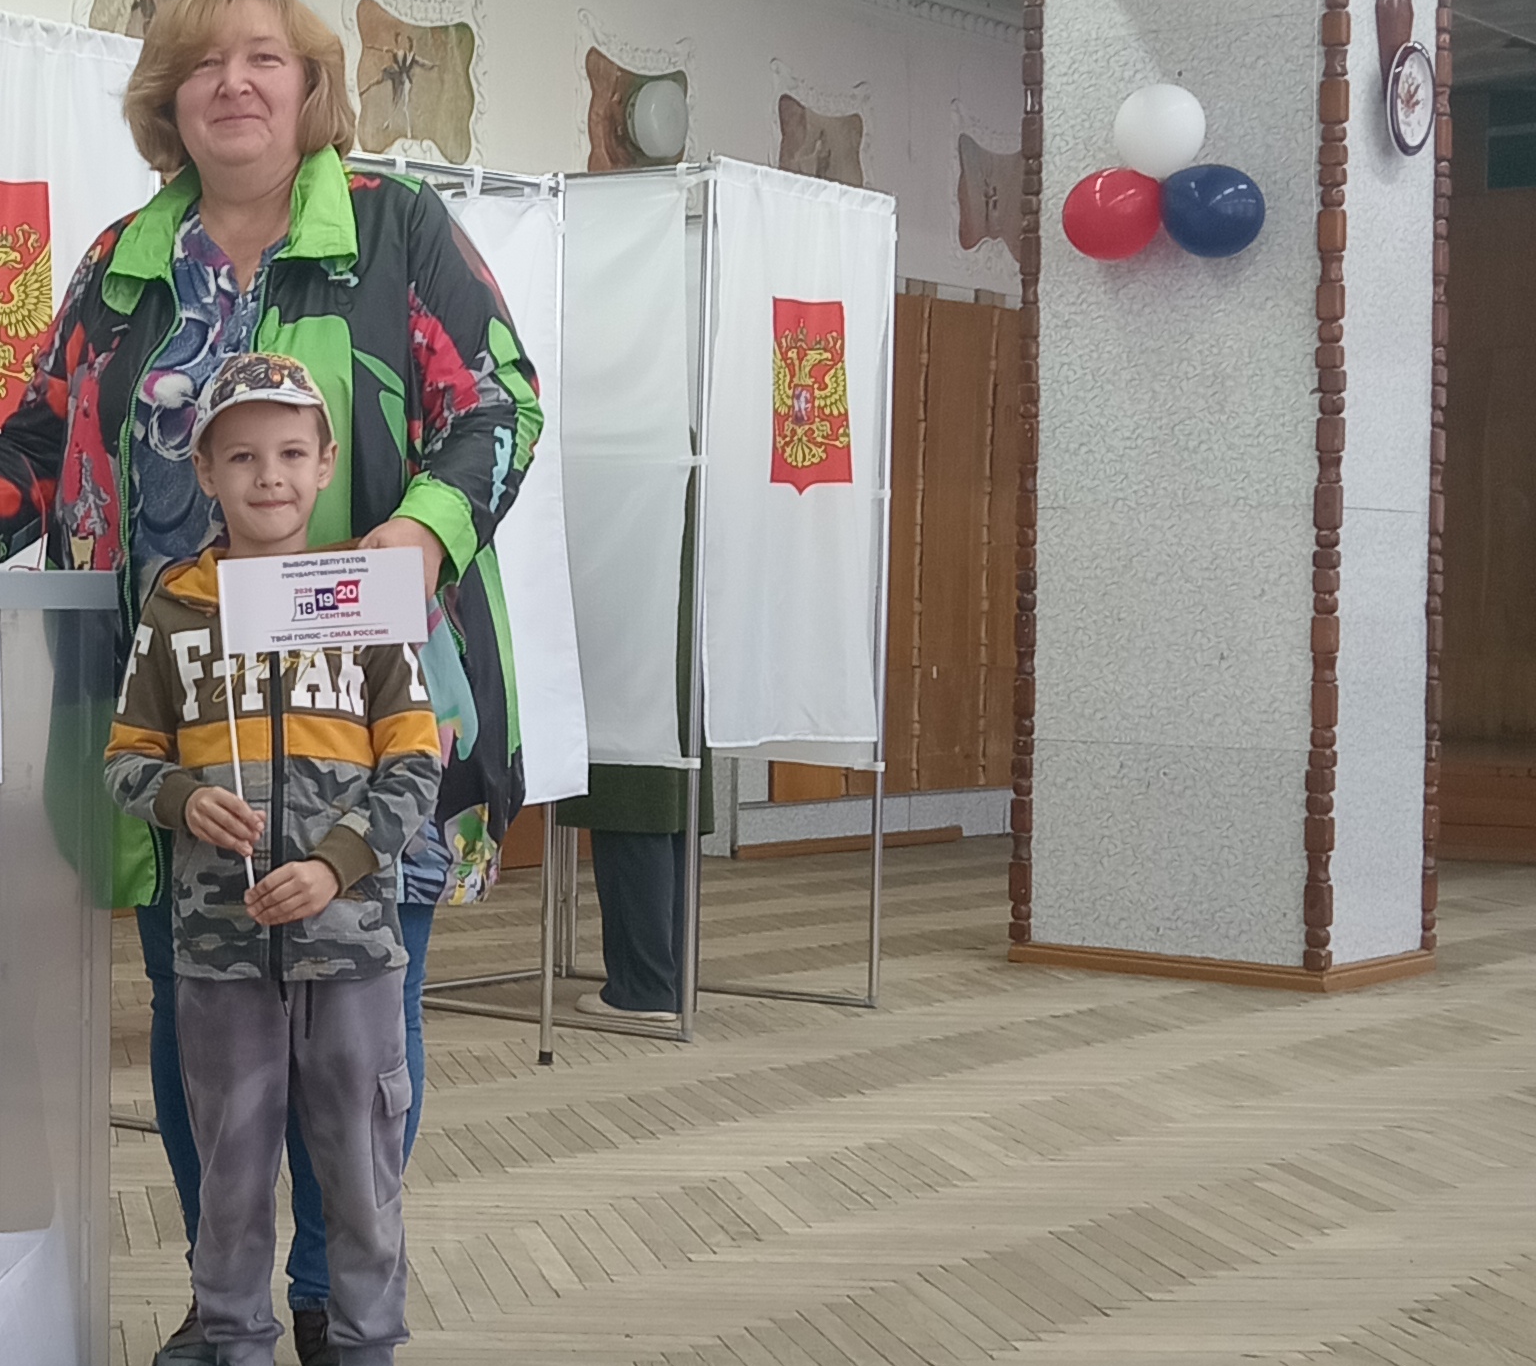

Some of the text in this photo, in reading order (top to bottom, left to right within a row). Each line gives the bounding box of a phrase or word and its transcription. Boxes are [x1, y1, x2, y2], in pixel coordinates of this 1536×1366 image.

[282, 556, 367, 568] ВЫБОРЫ ДЕПУТАТОВ
[281, 568, 347, 579] ГОСУДАРСТВЕННОЙ
[297, 584, 357, 615] 18 19 20
[319, 610, 362, 620] СЕНТЯБРЯ
[270, 633, 293, 643] ТВОЙ
[294, 632, 321, 641] ГОЛОС
[329, 630, 352, 638] СИЛА
[353, 628, 389, 637] РОССИИ!
